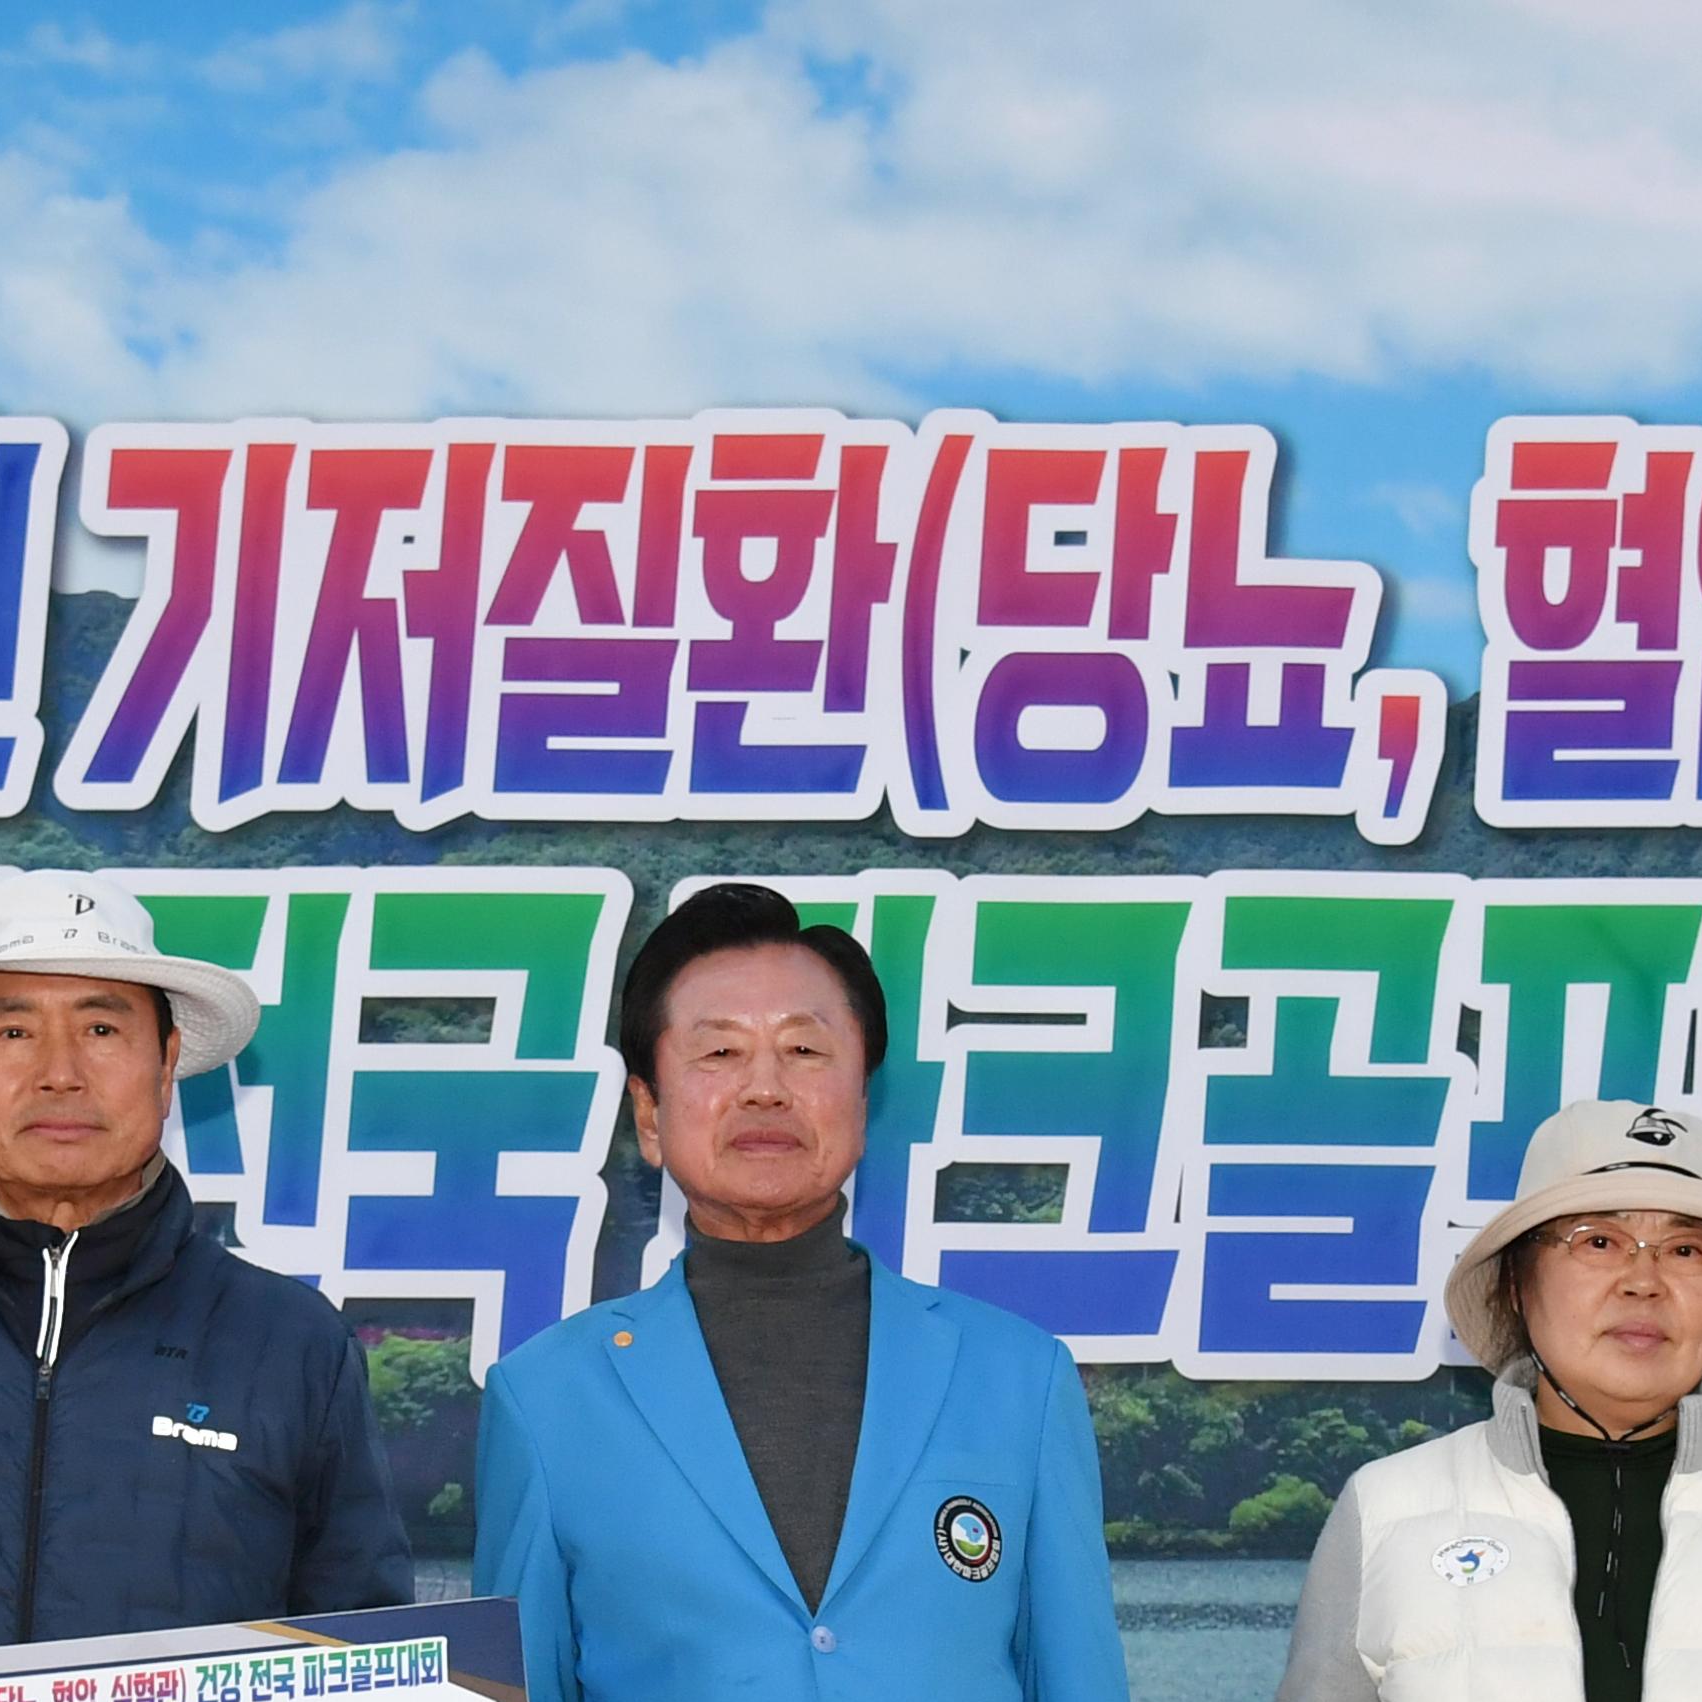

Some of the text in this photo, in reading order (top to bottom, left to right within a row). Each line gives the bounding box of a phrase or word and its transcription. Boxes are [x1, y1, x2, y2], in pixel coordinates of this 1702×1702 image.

[85, 432, 1422, 822] 기저질환(당뇨,
[248, 1656, 296, 1702] 전국
[302, 1640, 444, 1697] 파크골프대회
